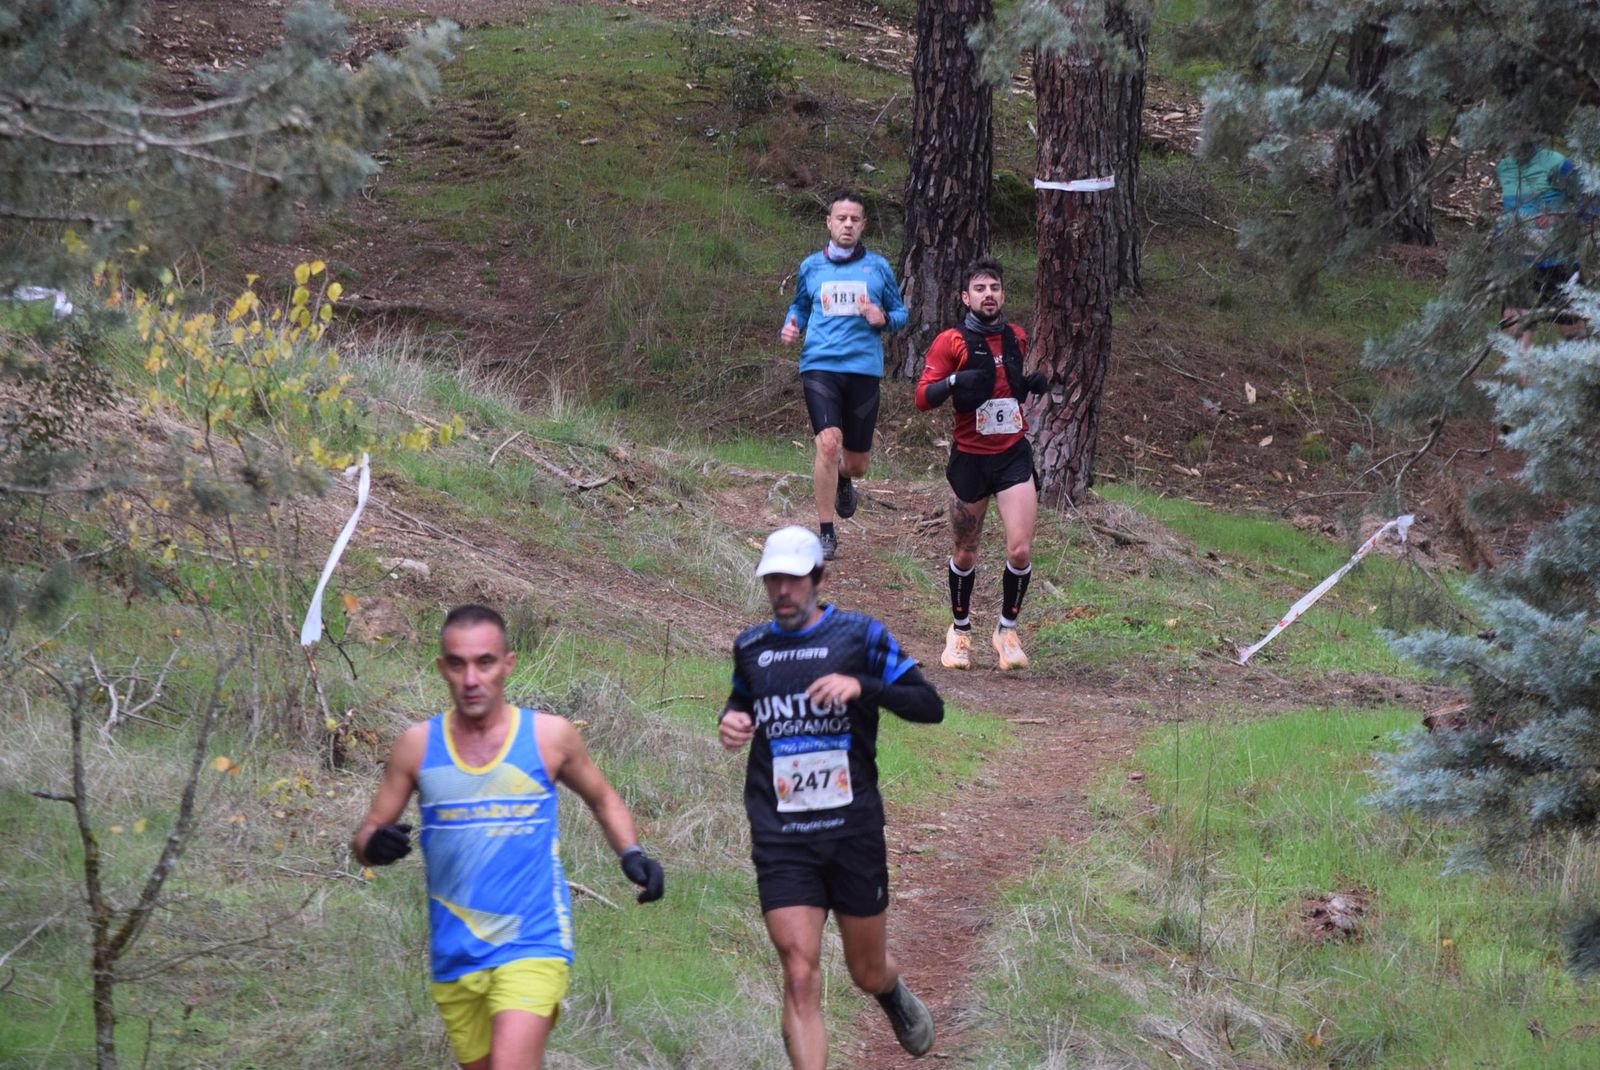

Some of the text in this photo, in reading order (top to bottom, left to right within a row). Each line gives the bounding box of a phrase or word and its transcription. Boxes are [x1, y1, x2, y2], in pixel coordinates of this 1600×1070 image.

[996, 410, 1004, 422] 6
[766, 716, 851, 739] LOGRAMOS
[791, 768, 831, 793] 247
